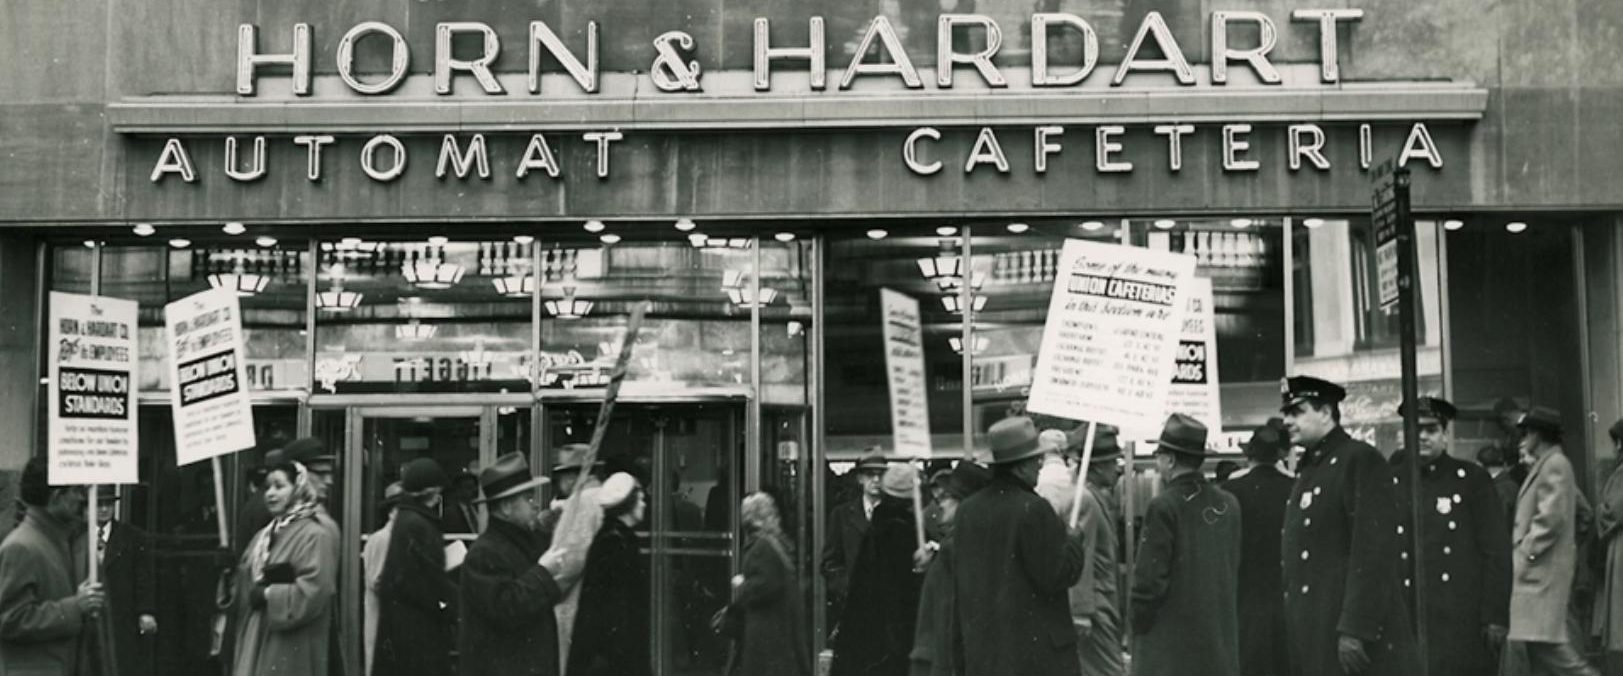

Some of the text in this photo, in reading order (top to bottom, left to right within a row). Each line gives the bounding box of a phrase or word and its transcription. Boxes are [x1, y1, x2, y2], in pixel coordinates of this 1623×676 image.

[236, 8, 1364, 97] HORN & HARDART
[150, 131, 624, 183] AUTOMAT
[903, 122, 1444, 176] CAFETERIA
[1068, 274, 1176, 305] UNION CAFETERIAS
[207, 352, 235, 377] UNION
[1178, 343, 1205, 362] NION
[60, 371, 129, 394] BELOW UNION
[183, 372, 236, 402] STANDARDS
[64, 394, 125, 415] STANDARDS
